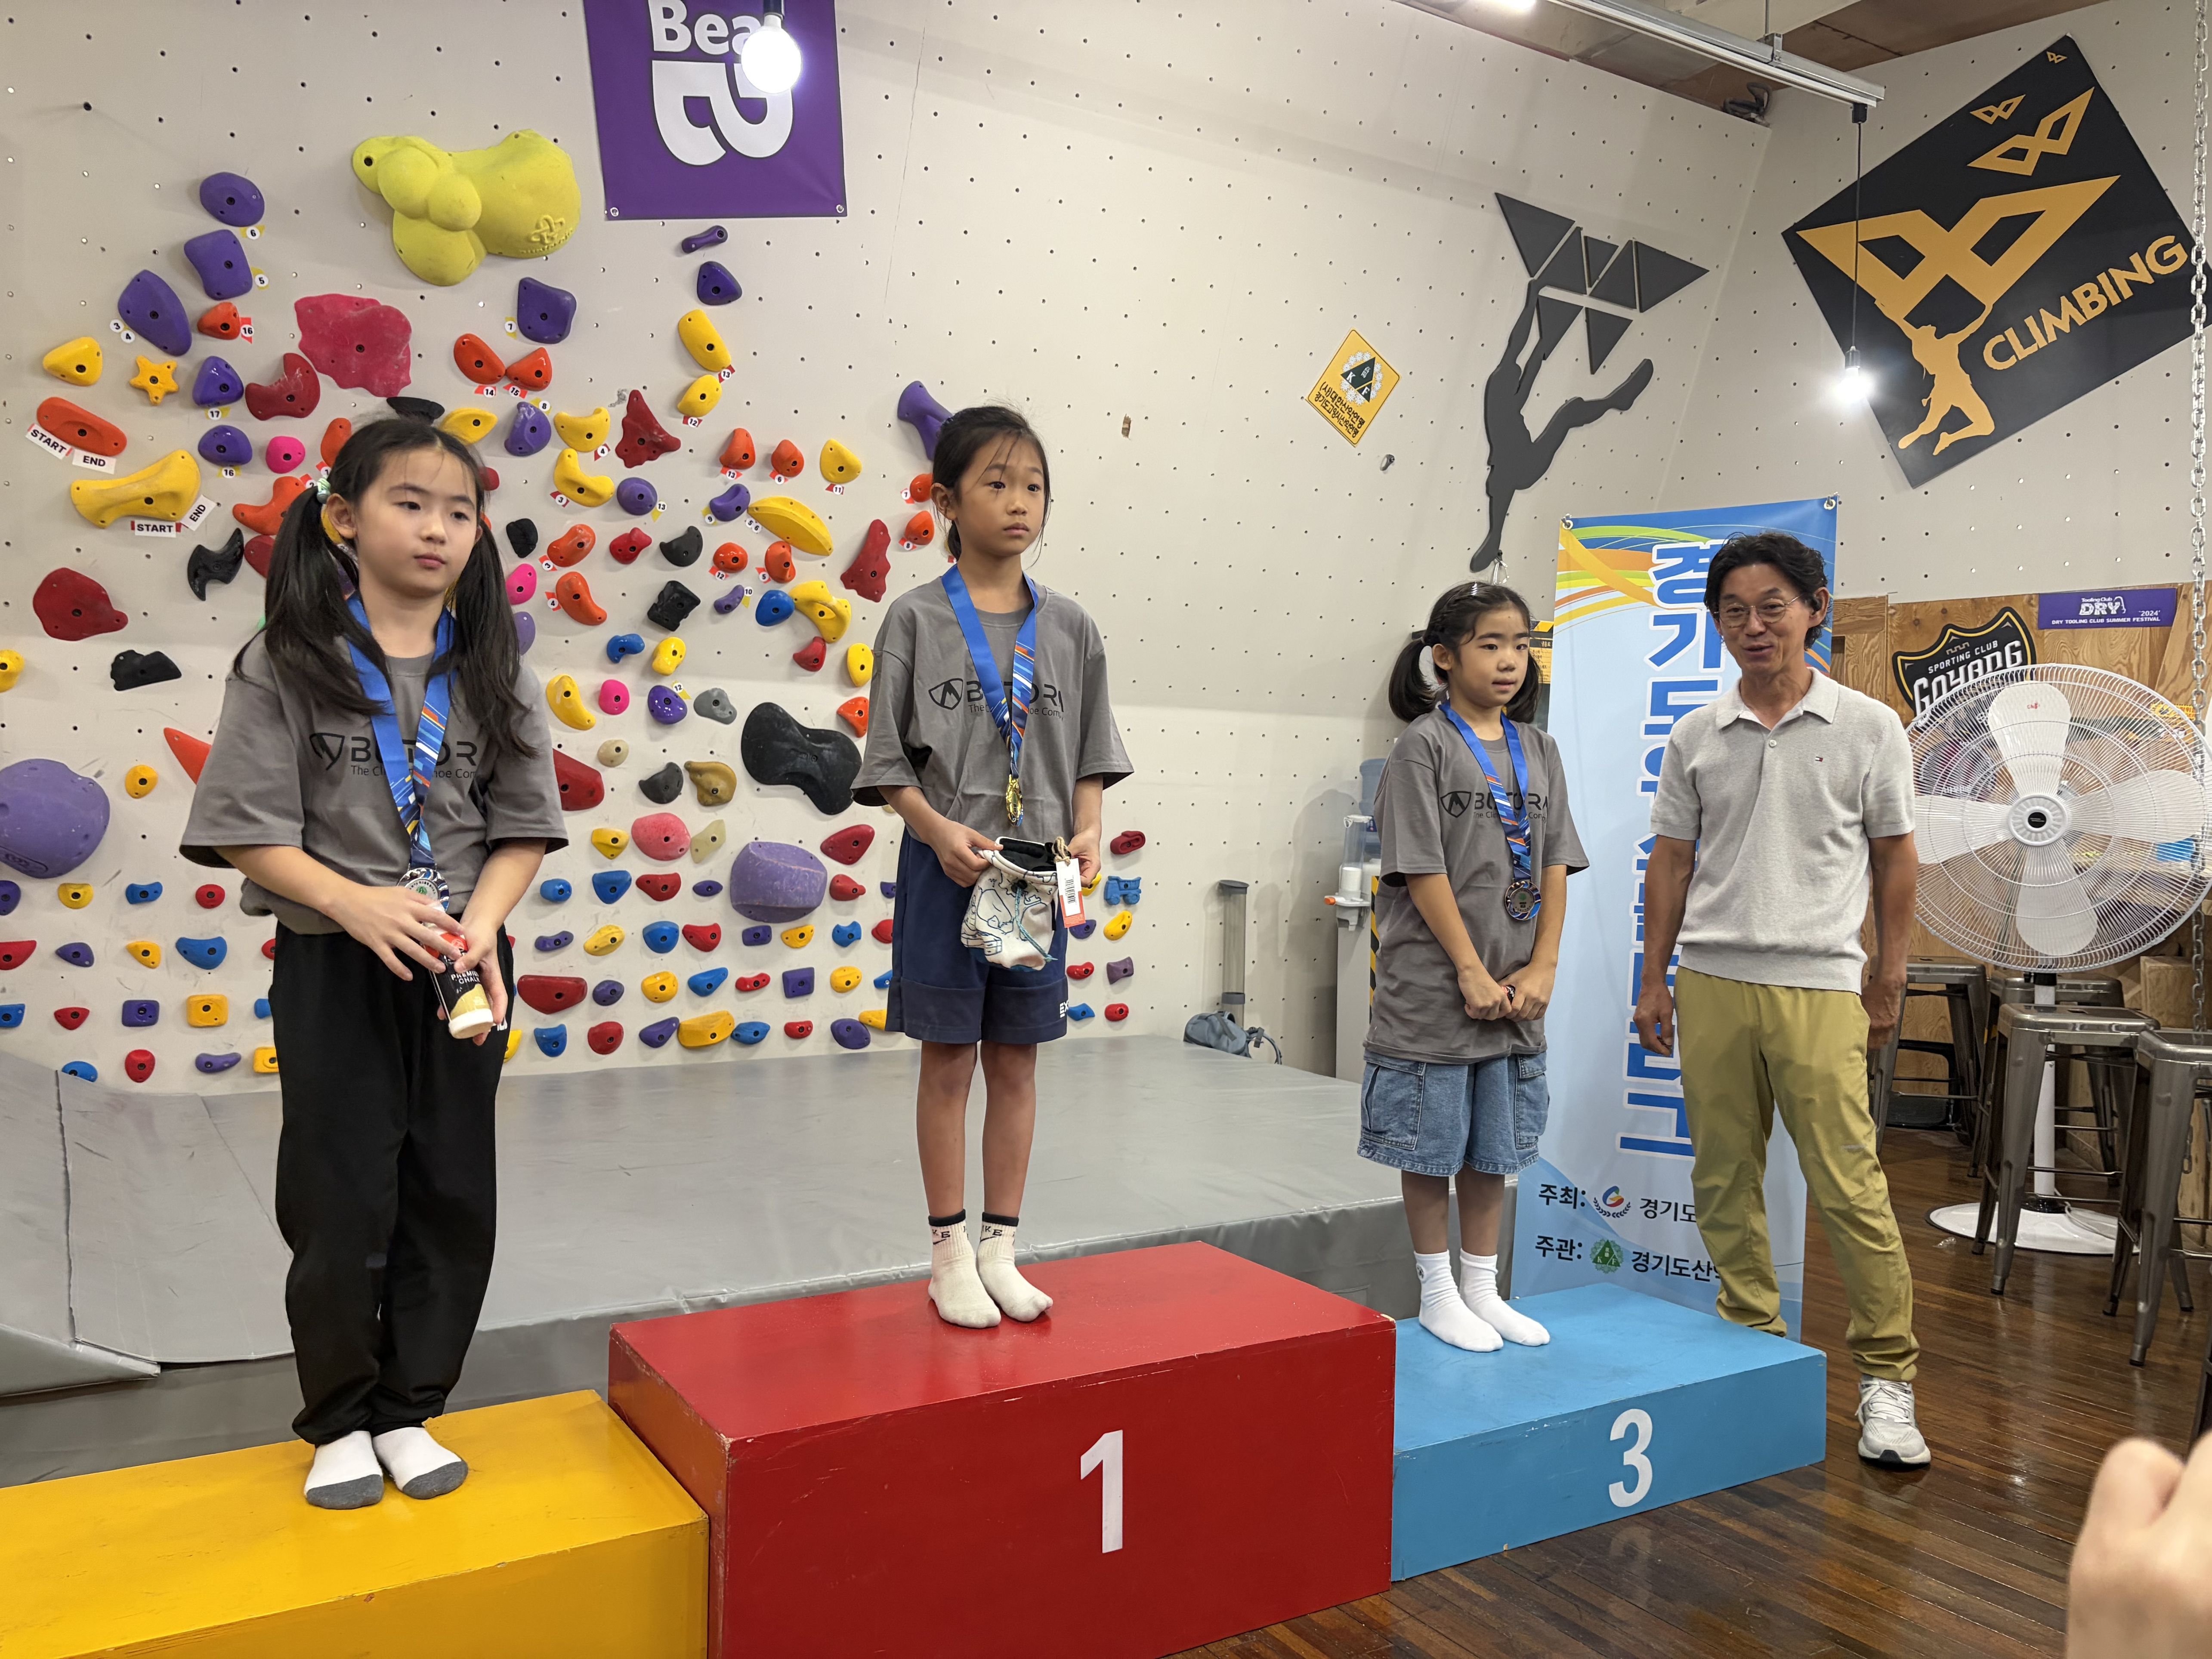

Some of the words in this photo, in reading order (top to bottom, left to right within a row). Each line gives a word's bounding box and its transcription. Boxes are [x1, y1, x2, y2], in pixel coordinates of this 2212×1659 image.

[1983, 235, 2189, 371] CLIMBING
[1346, 371, 1356, 383] K
[511, 387, 519, 396] 15
[1361, 386, 1370, 395] F
[31, 429, 67, 453] START
[83, 455, 106, 467] END
[189, 504, 206, 522] END
[137, 524, 173, 532] START
[2079, 602, 2120, 615] DRY
[1928, 651, 1971, 674] SPORTING
[1974, 640, 1998, 655] CLUB
[969, 704, 985, 713] The
[351, 765, 369, 776] The
[1538, 1183, 1586, 1209] 주최:
[1640, 1198, 1696, 1223] 경기도
[1535, 1235, 1582, 1261] 주관:
[1631, 1250, 1721, 1282] 경기도산
[1608, 1408, 1653, 1509] 3
[1080, 1429, 1124, 1554] 1
